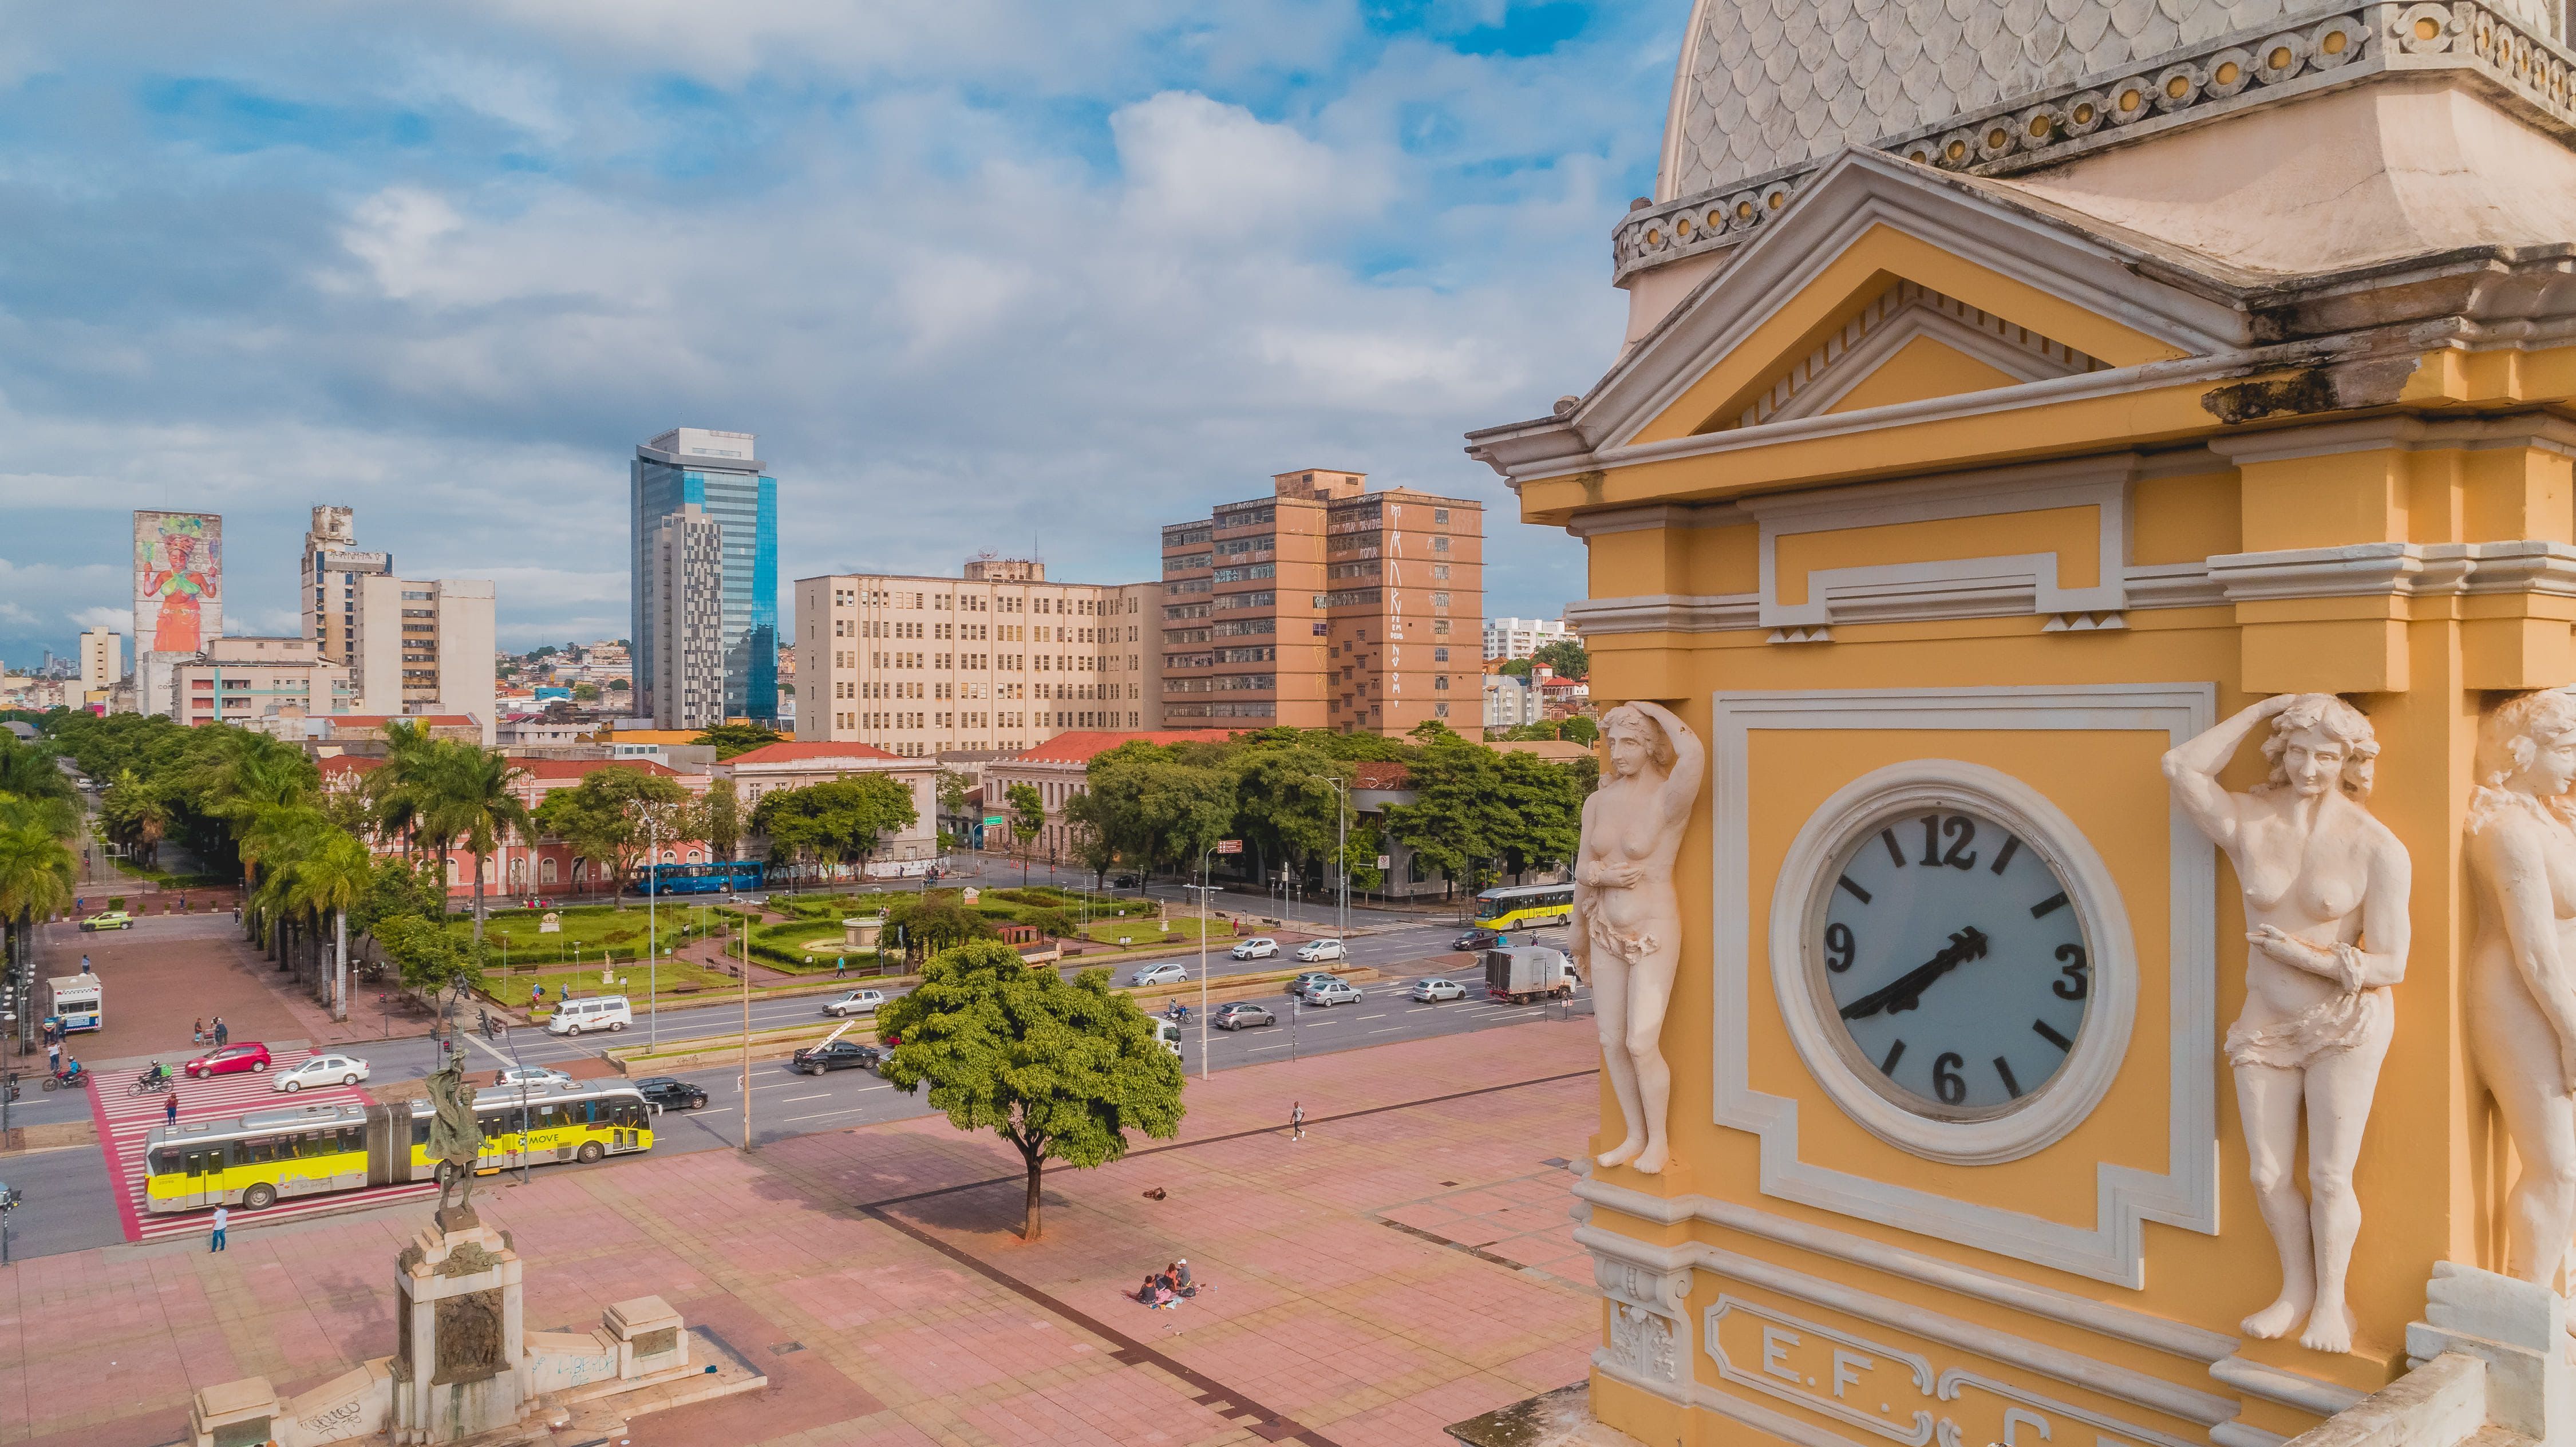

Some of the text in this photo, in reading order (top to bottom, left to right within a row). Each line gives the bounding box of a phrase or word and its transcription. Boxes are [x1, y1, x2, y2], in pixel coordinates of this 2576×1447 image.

[1919, 815, 1977, 871] 12
[1826, 922, 1855, 973] 9
[2053, 943, 2087, 1001] 3
[1933, 1052, 1966, 1105] 6
[529, 1134, 559, 1145] MOVE
